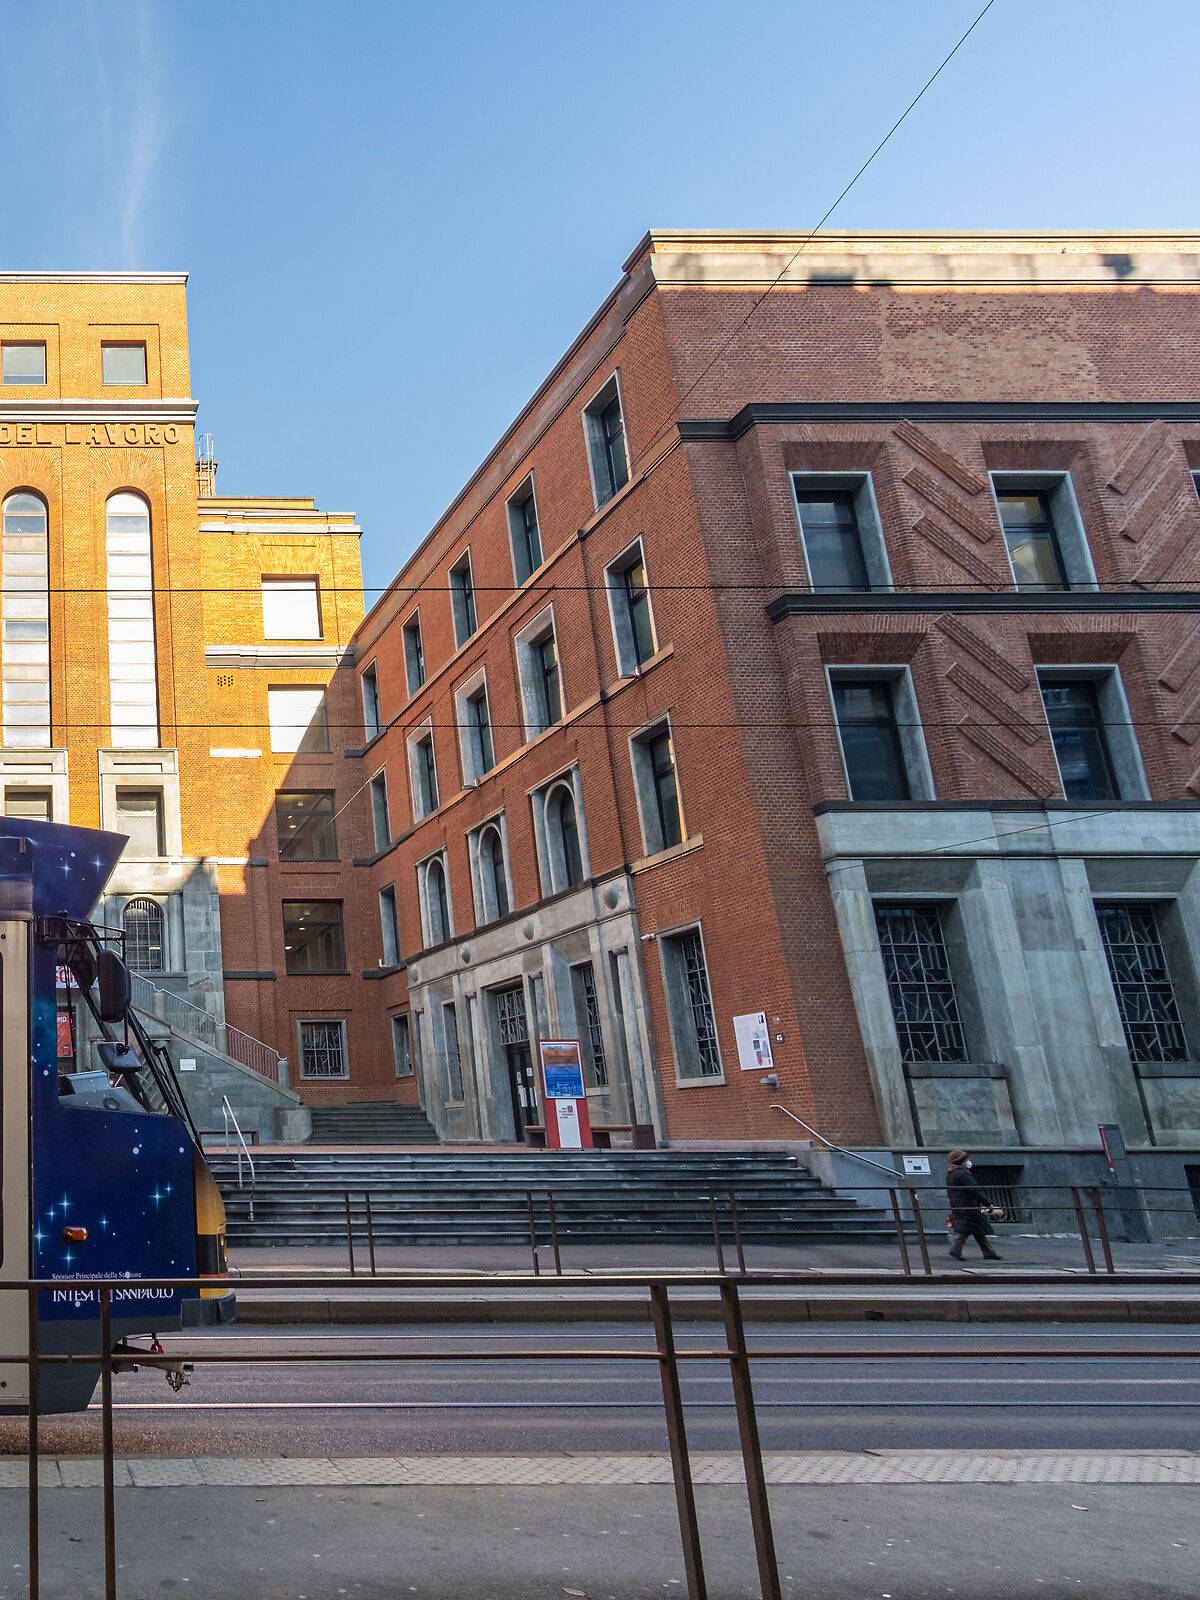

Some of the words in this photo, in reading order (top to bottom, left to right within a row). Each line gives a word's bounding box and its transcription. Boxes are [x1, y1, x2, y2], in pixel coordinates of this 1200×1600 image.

[65, 423, 181, 444] LAVORO
[52, 1272, 75, 1280] Sponsor
[76, 1272, 103, 1280] Principale
[104, 1271, 118, 1279] della
[119, 1271, 142, 1279] Stione
